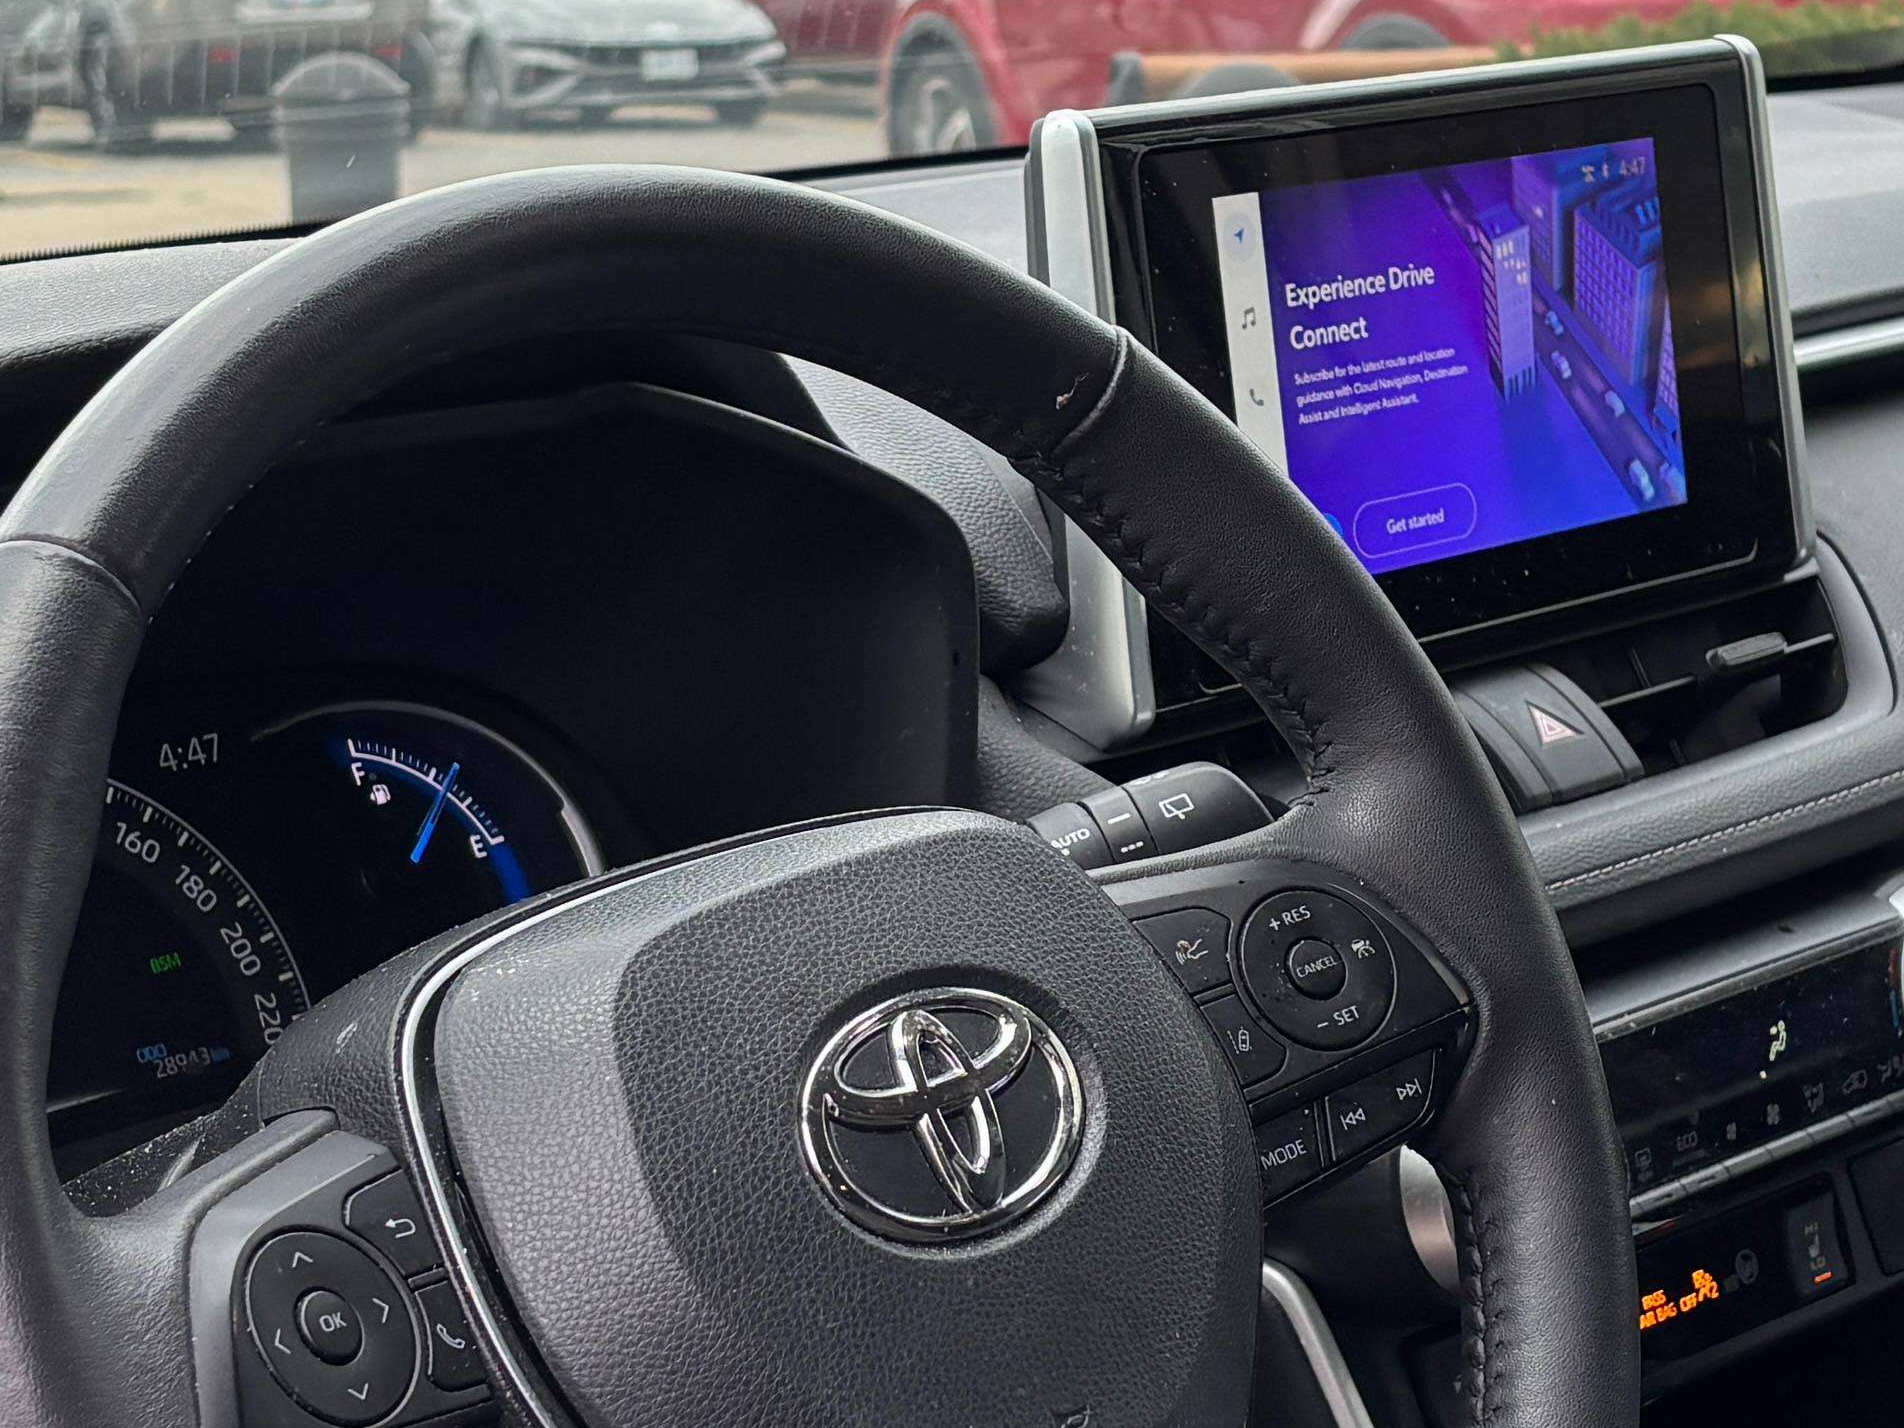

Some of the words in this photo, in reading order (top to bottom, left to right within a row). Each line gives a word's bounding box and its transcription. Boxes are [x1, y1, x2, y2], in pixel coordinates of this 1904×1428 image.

[1285, 274, 1386, 309] Experience
[1388, 263, 1436, 291] Drive
[1290, 317, 1368, 349] Connect
[1294, 368, 1334, 386] Subscribe
[1361, 359, 1385, 374] latest
[1385, 356, 1407, 371] route
[1424, 348, 1455, 363] location
[1296, 389, 1335, 408] guidance
[1335, 385, 1353, 399] with
[1353, 380, 1378, 395] Cloud
[1424, 364, 1469, 382] Destination
[1298, 408, 1323, 425] Assist
[1340, 400, 1381, 416] Intelligent
[1386, 517, 1407, 534] Get
[1408, 507, 1445, 530] started
[158, 733, 221, 771] 4:47
[351, 761, 366, 787] F
[113, 821, 161, 864] 160
[469, 834, 489, 859] E
[1051, 828, 1090, 848] AUTO
[172, 865, 218, 914] 180
[219, 923, 262, 977] 200
[1295, 954, 1339, 979] CANCEL
[253, 991, 284, 1045] 220
[1261, 1138, 1308, 1170] MODE
[318, 1311, 347, 1333] OK
